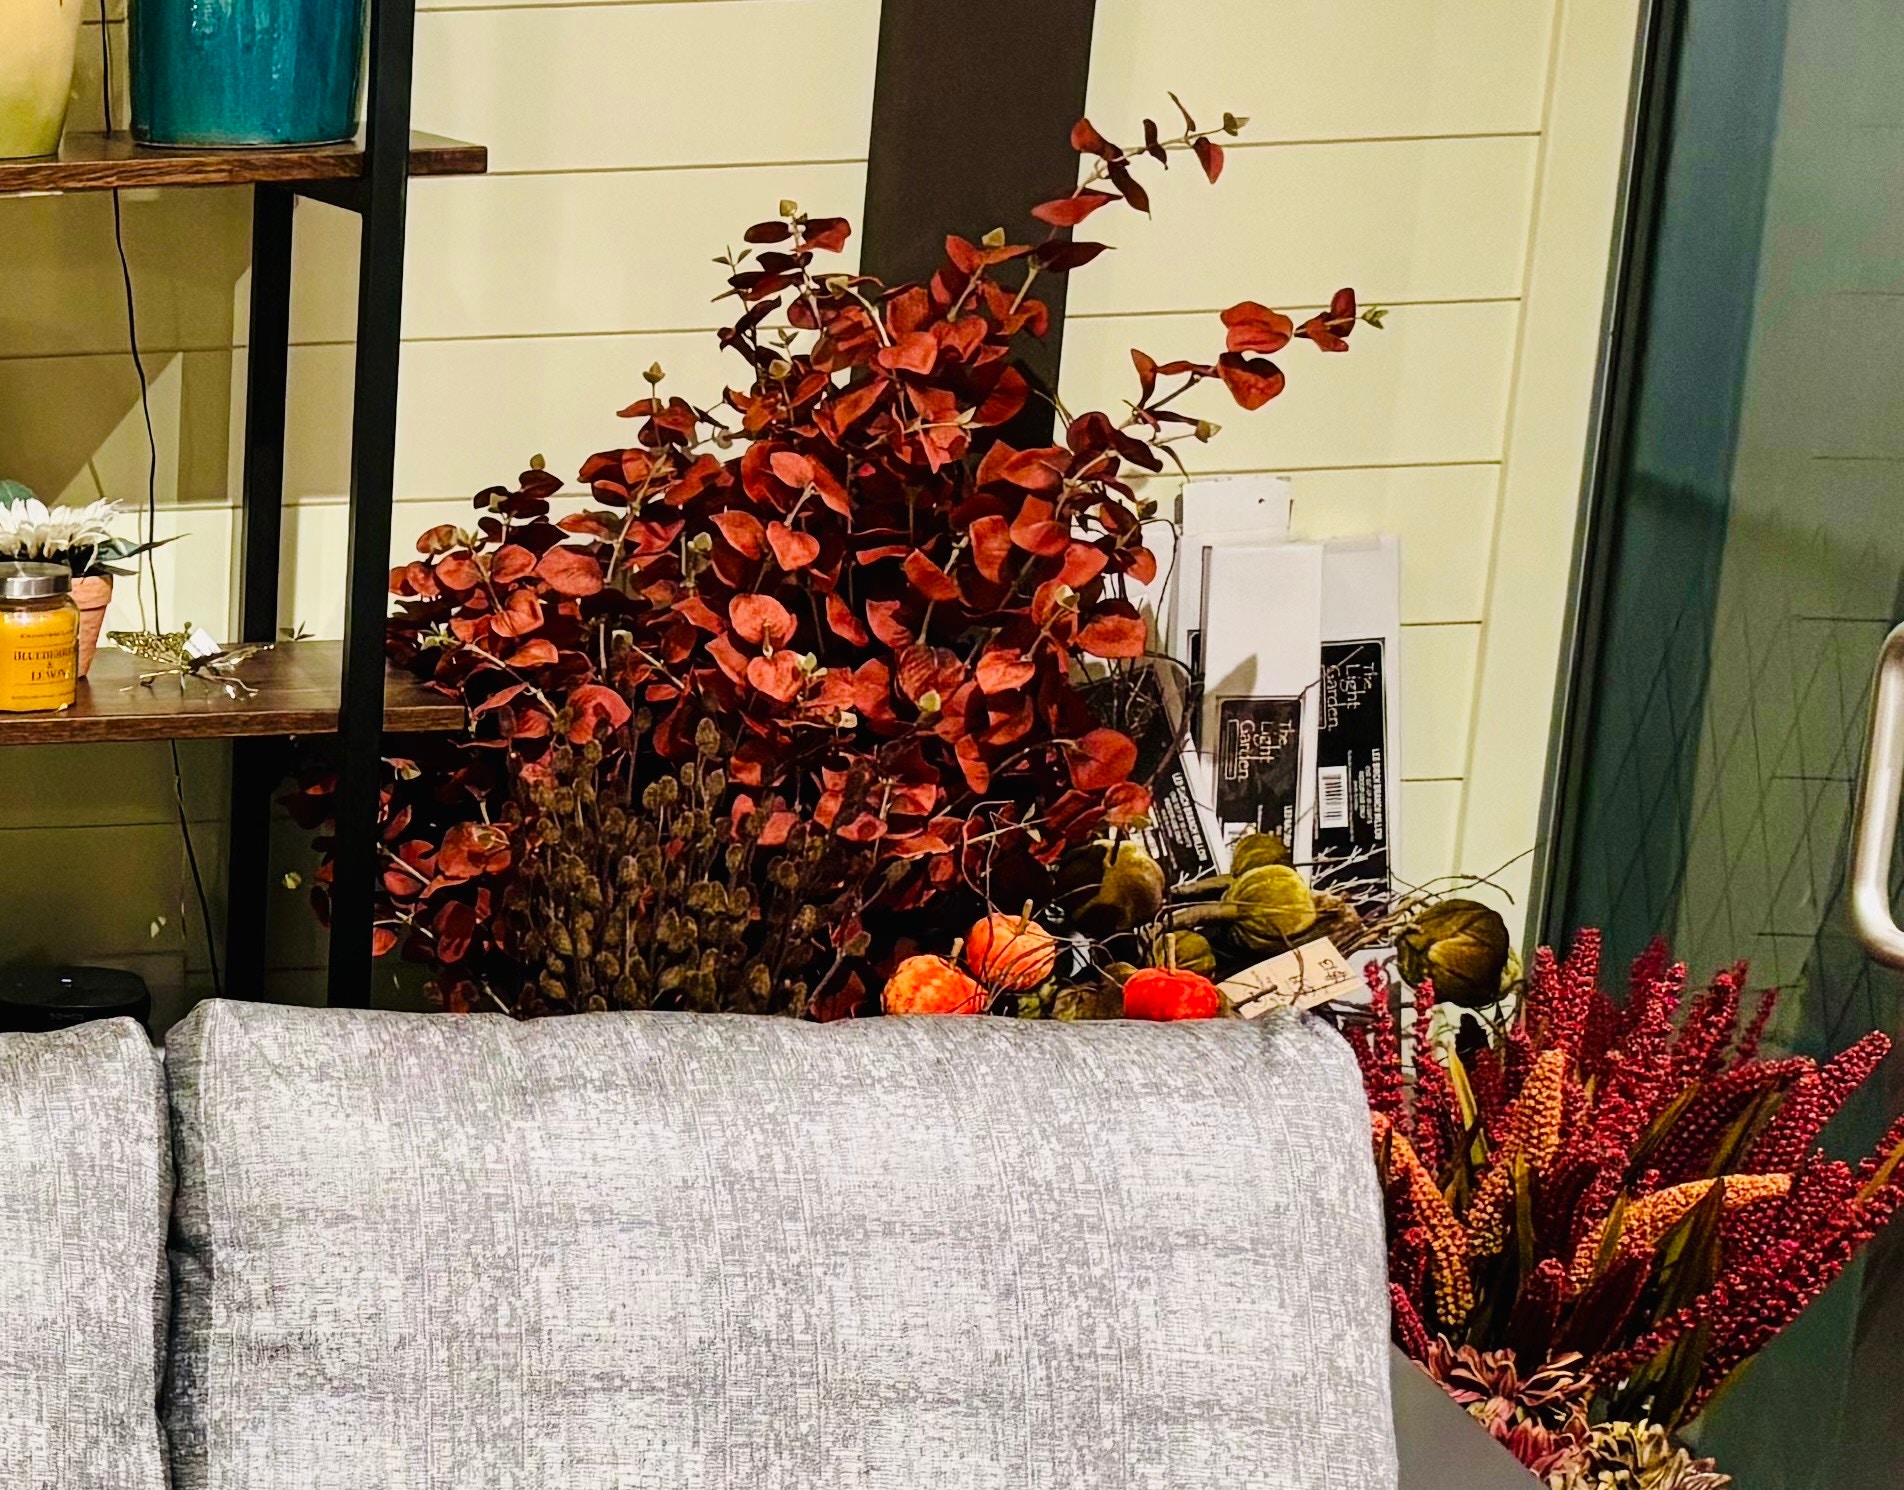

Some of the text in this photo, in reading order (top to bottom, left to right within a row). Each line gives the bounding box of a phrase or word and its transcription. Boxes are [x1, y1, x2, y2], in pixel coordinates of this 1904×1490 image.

[1339, 664, 1366, 710] Light
[1363, 662, 1378, 690] The
[1253, 721, 1281, 764] Light
[1279, 720, 1295, 746] The
